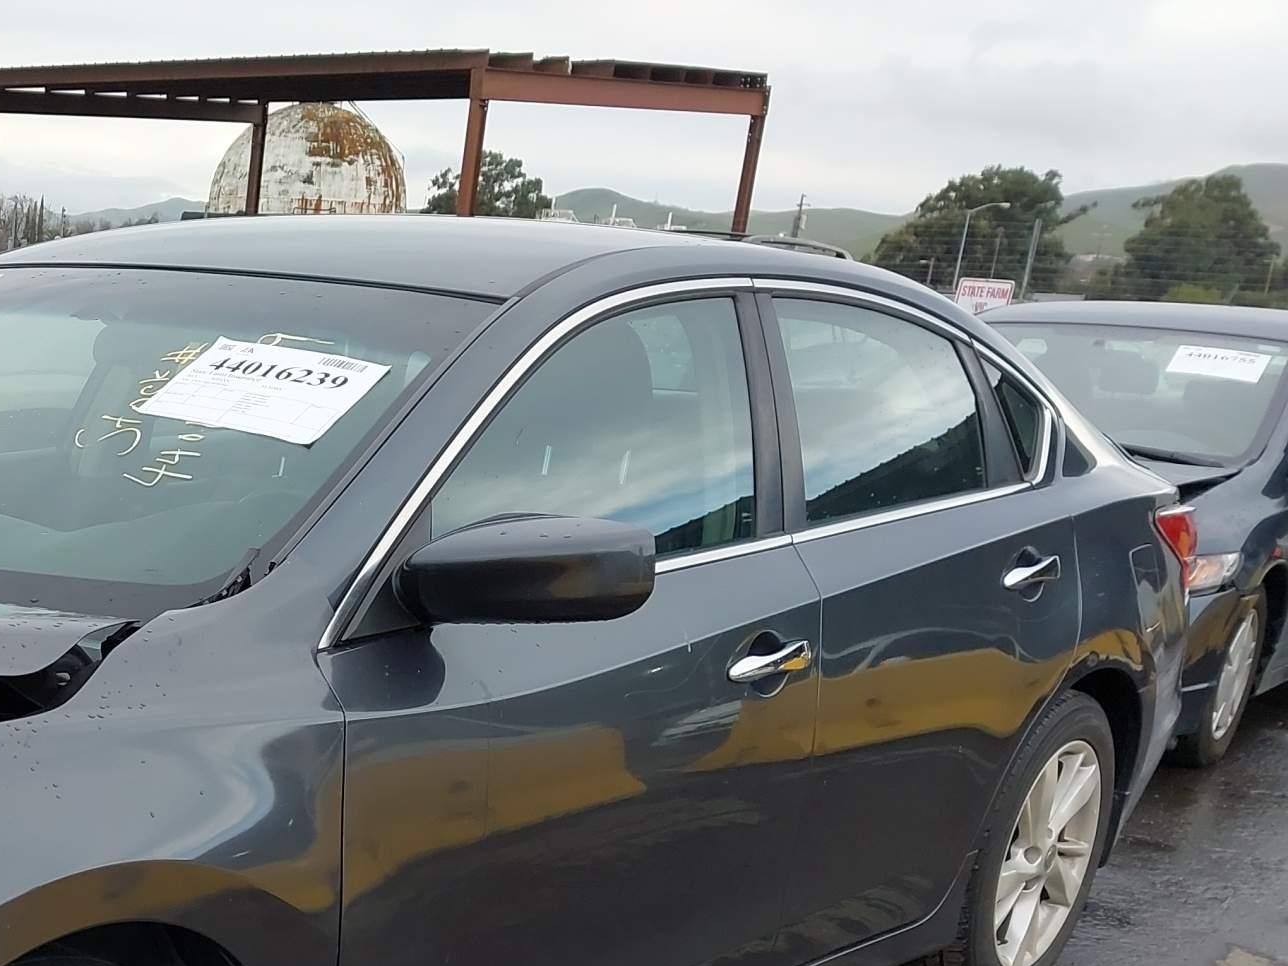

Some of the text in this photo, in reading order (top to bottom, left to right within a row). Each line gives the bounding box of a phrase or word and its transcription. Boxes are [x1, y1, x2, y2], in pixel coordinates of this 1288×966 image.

[961, 285, 1009, 299] STATE FARM
[209, 357, 350, 389] 44016239
